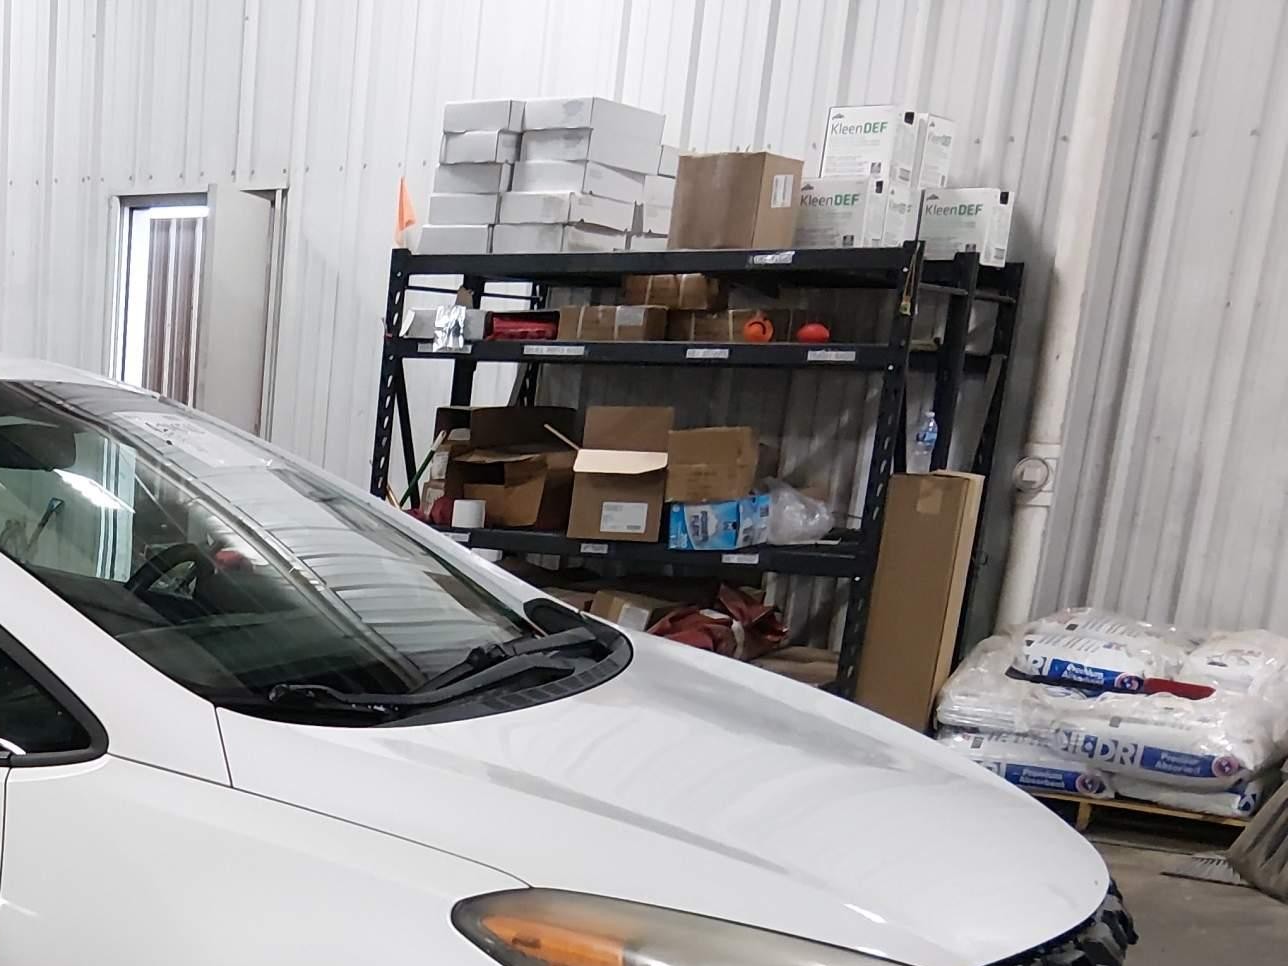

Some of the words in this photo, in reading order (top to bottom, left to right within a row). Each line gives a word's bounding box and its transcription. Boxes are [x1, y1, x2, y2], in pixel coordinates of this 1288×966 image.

[831, 121, 889, 135] KleenDEF
[799, 193, 859, 207] KleenDEF
[925, 203, 983, 216] KleenDEF
